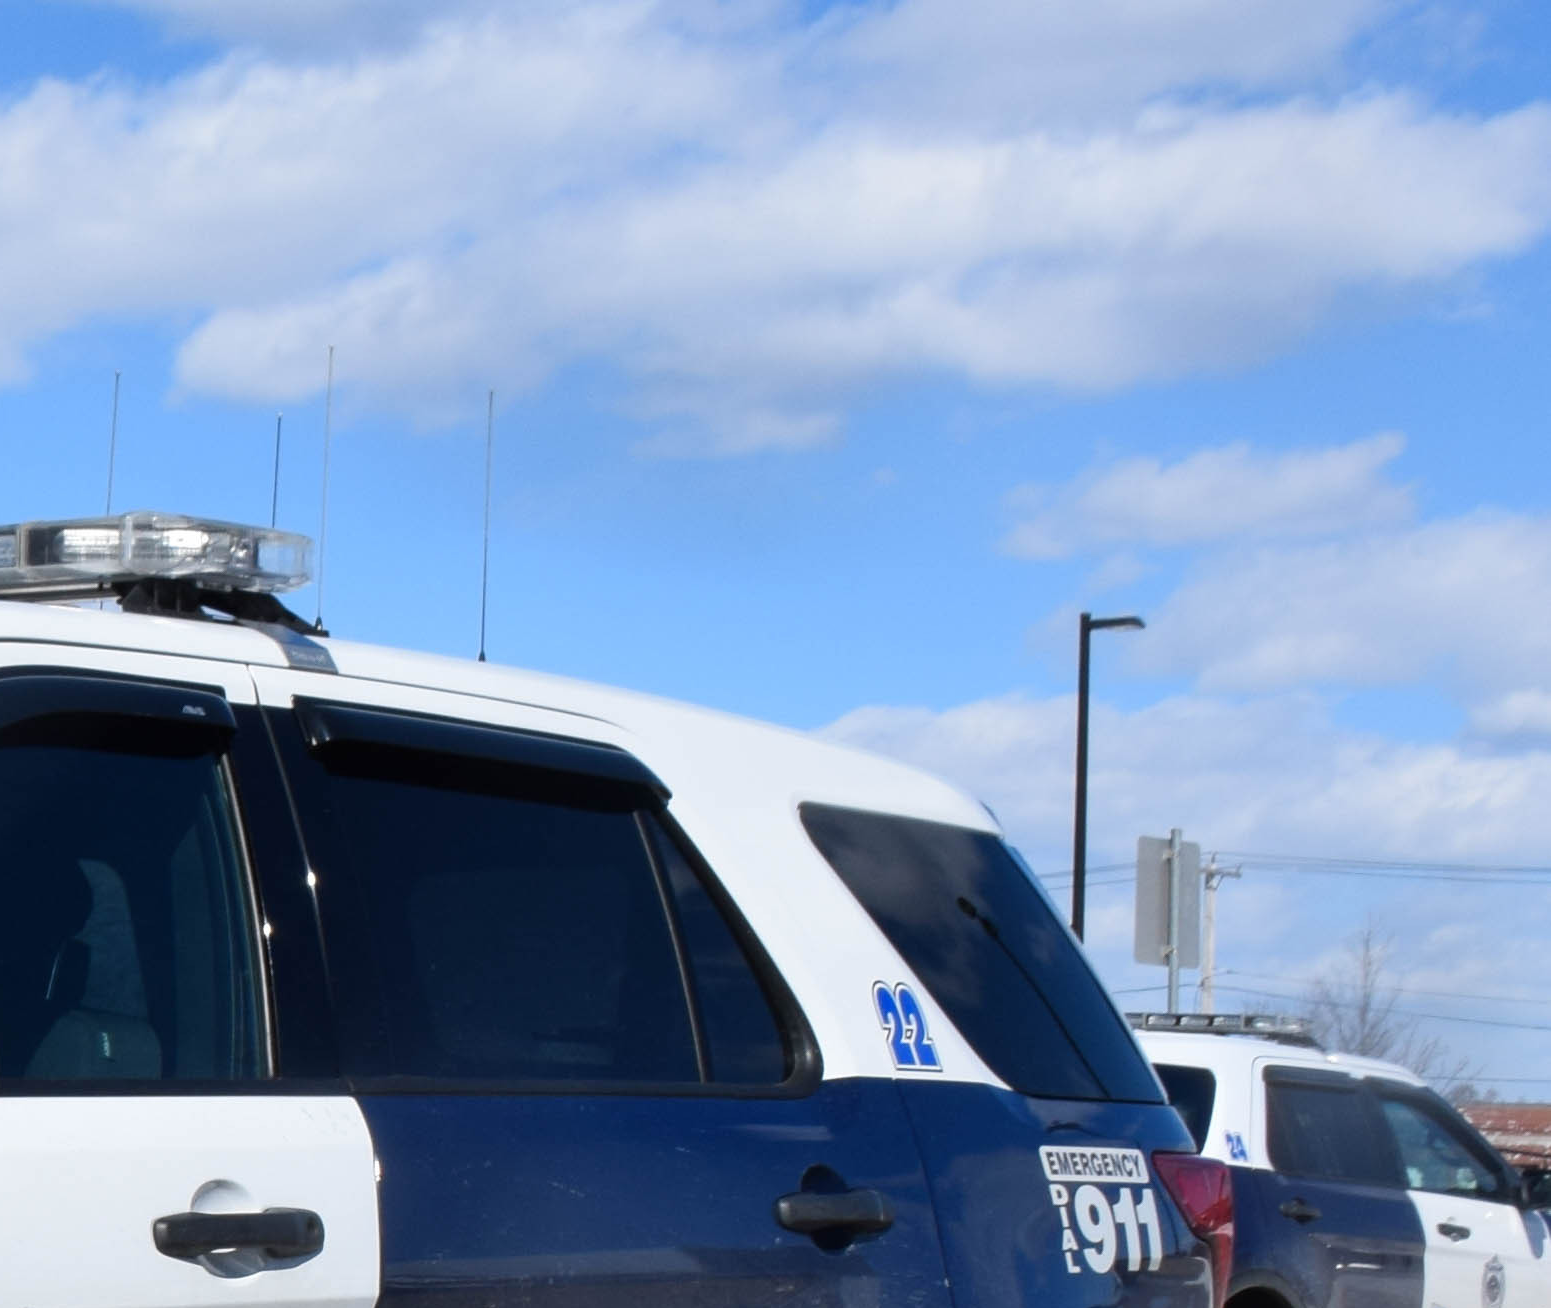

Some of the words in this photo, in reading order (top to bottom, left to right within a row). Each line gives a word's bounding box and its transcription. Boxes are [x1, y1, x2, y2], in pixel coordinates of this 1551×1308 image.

[872, 980, 943, 1073] 22
[1045, 1151, 1142, 1178] EMERGENCY
[1224, 1132, 1248, 1162] 24
[1048, 1183, 1082, 1274] DIAL
[1074, 1184, 1163, 1275] 911
